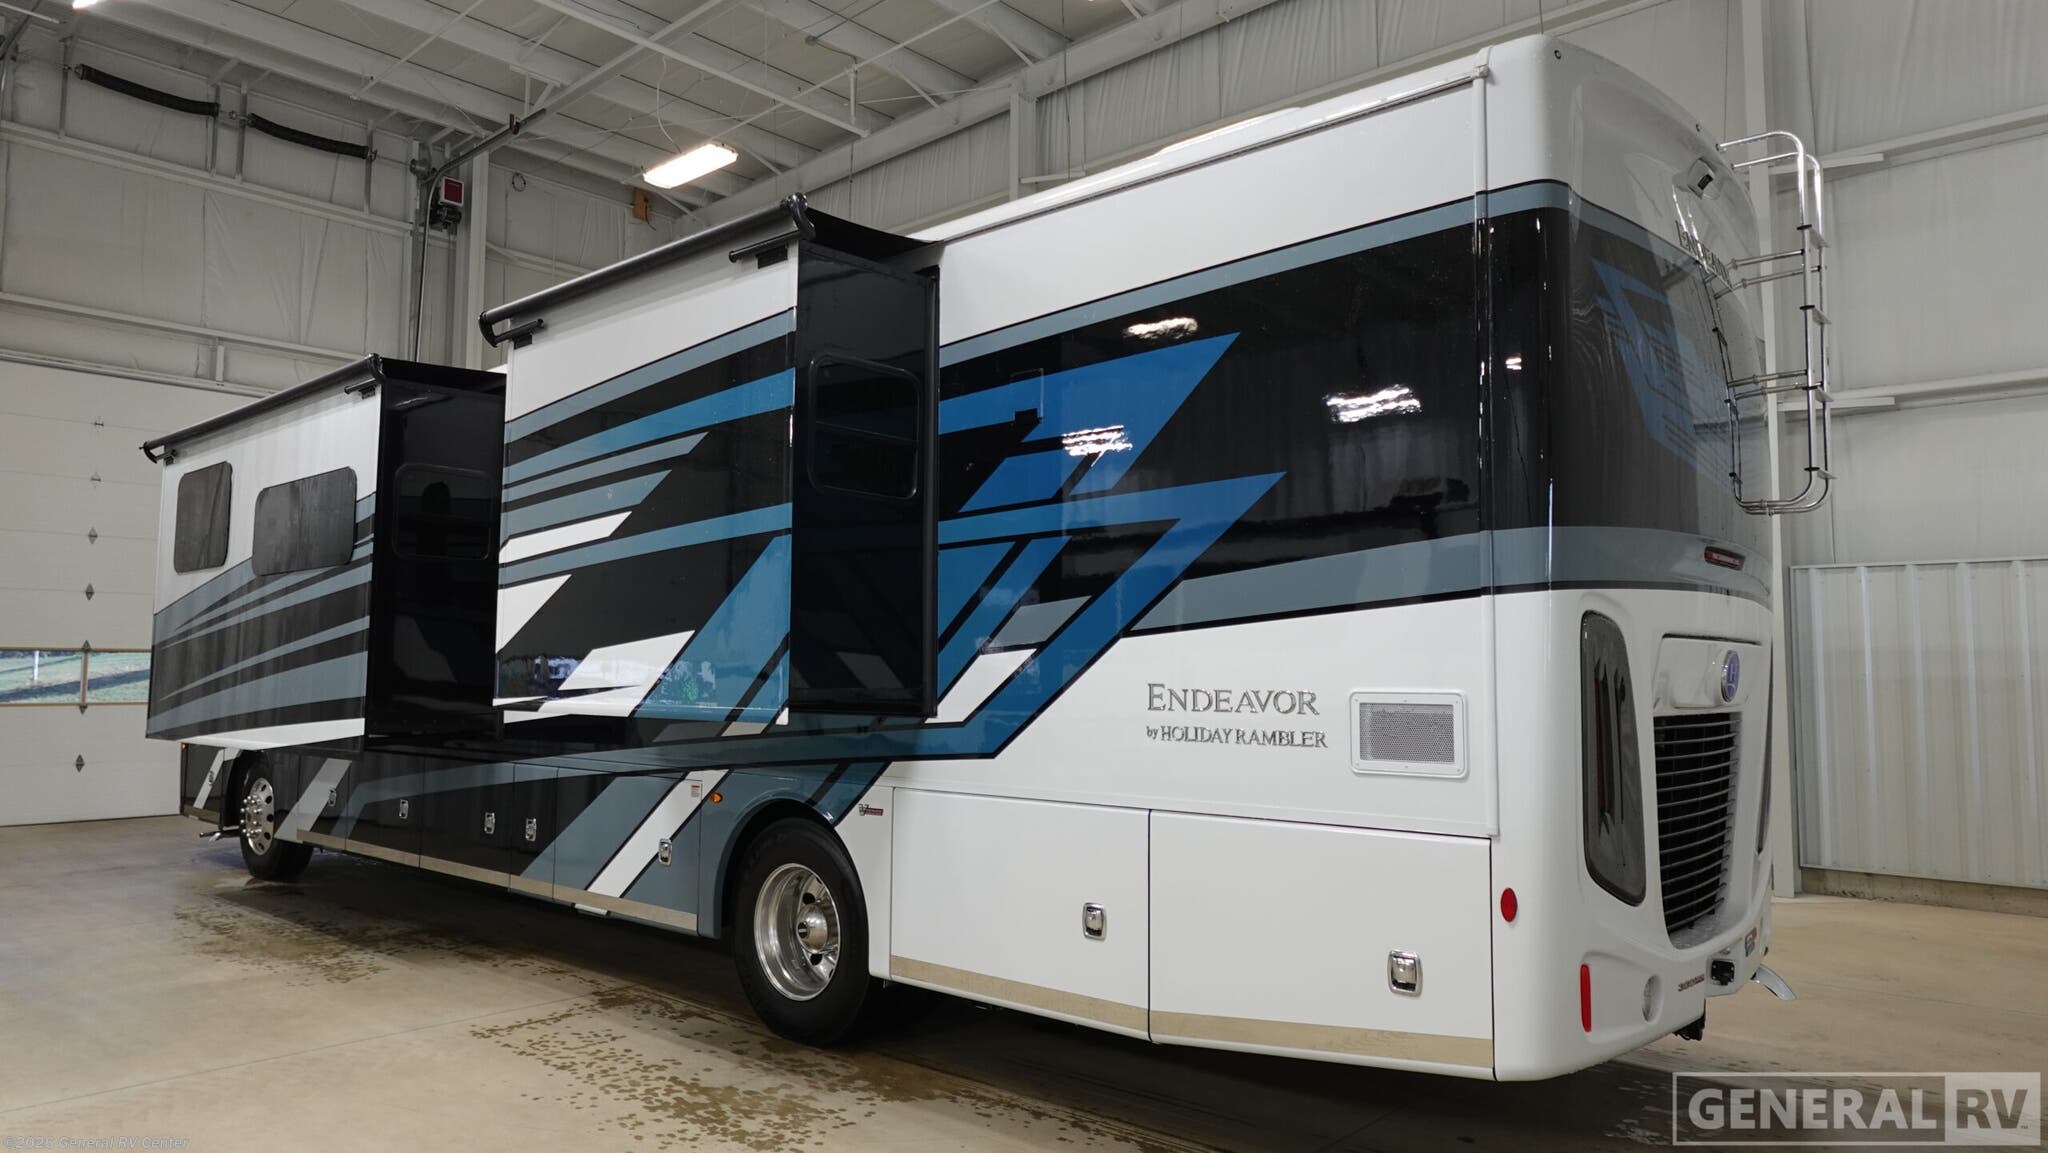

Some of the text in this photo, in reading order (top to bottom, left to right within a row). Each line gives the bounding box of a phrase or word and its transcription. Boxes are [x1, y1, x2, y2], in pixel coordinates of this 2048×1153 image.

[1147, 683, 1320, 715] ENDEAVOR
[1146, 725, 1328, 748] by HOLIDAY RAMBLER
